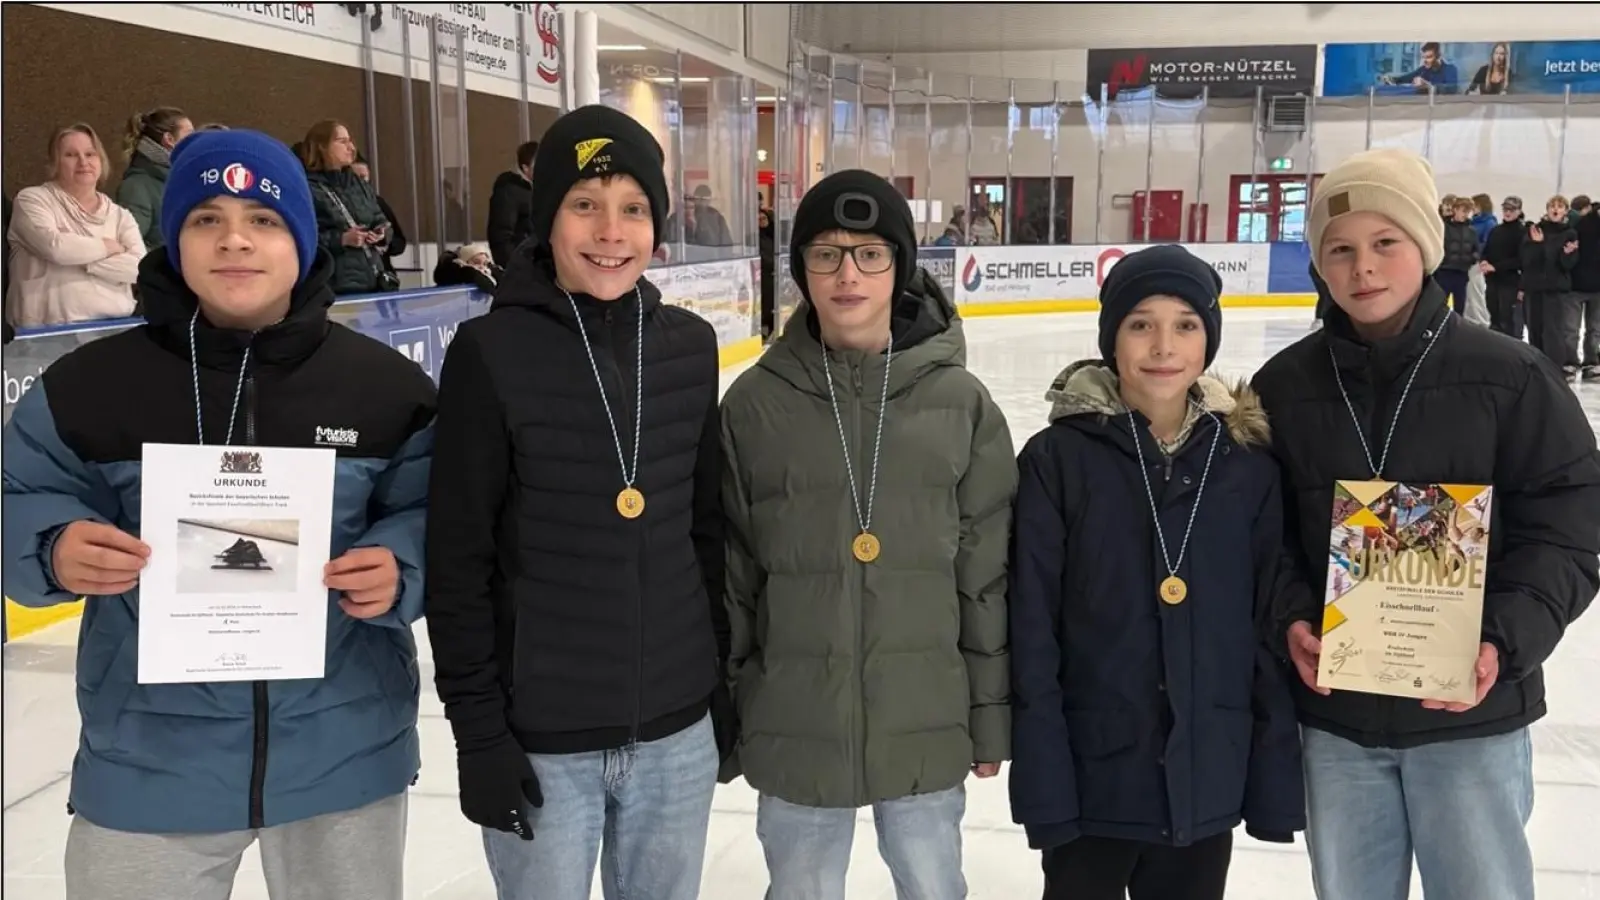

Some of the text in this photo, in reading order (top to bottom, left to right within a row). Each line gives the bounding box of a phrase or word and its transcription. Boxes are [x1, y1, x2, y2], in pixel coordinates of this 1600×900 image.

[472, 24, 502, 49] Partner
[503, 36, 515, 52] am
[1150, 59, 1296, 74] MOTOR-NÜTZEL
[1544, 59, 1577, 76] Jetzt
[200, 168, 281, 200] 19 53
[985, 261, 1094, 280] SCHMELLER
[214, 478, 267, 487] URKUNDE
[1349, 547, 1484, 589] URKUNDE
